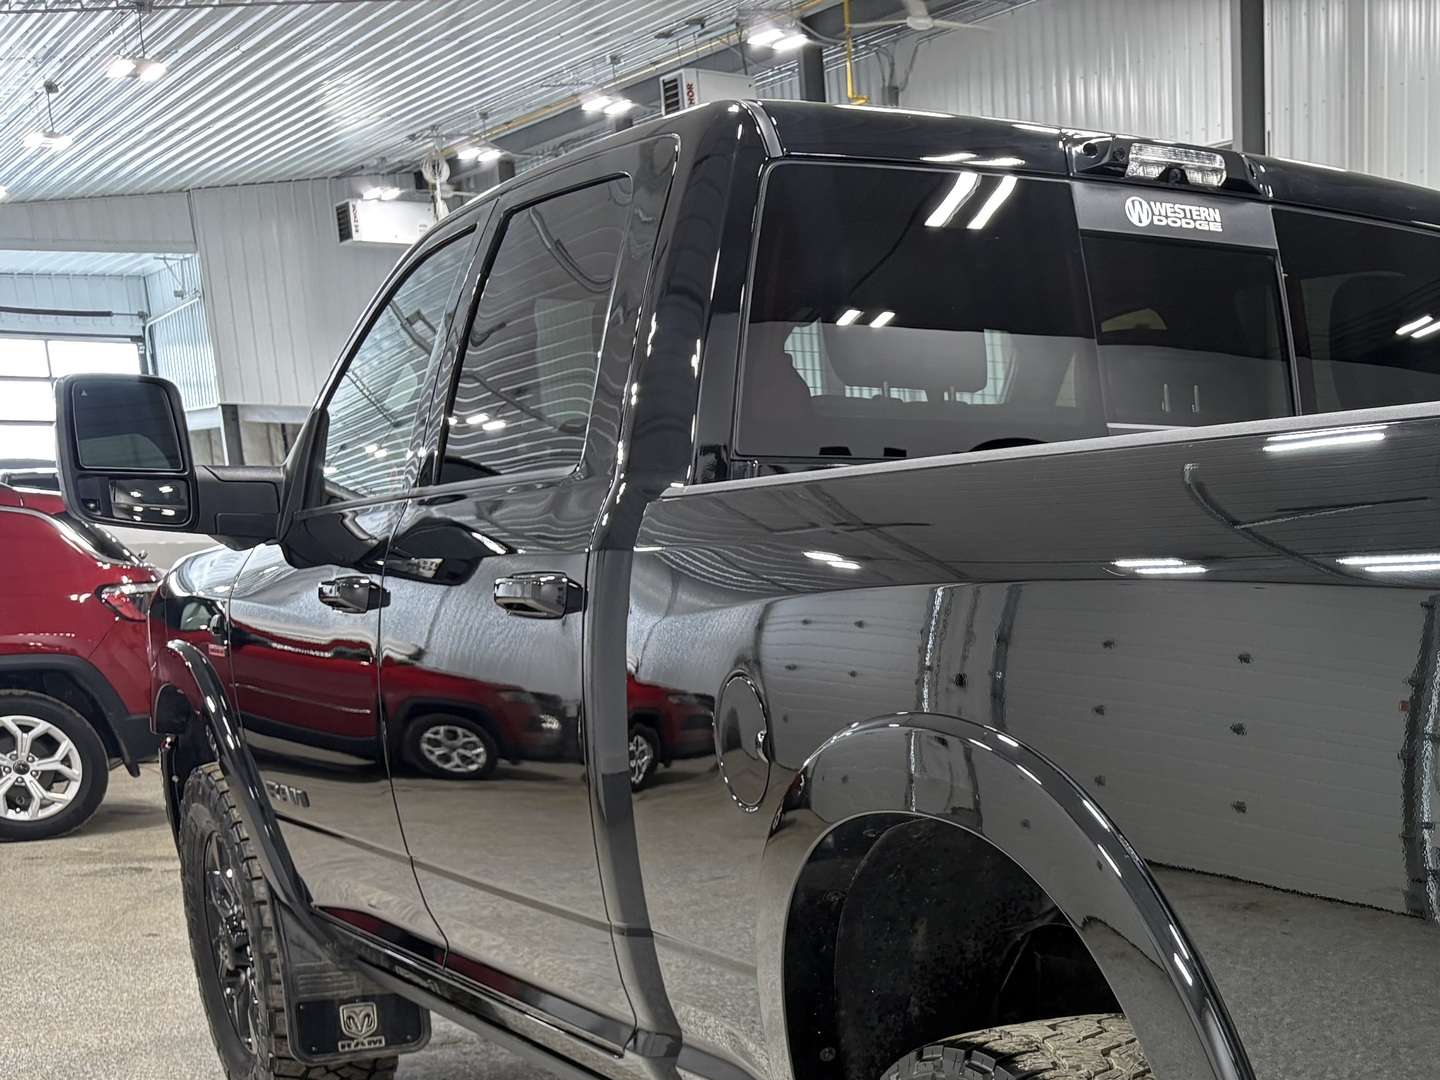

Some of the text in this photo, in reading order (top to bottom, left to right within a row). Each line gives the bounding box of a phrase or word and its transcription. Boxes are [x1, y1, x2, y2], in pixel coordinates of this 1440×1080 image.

[1150, 201, 1222, 222] WESTERN
[1153, 215, 1223, 232] DODGE
[338, 1036, 385, 1052] RAM
